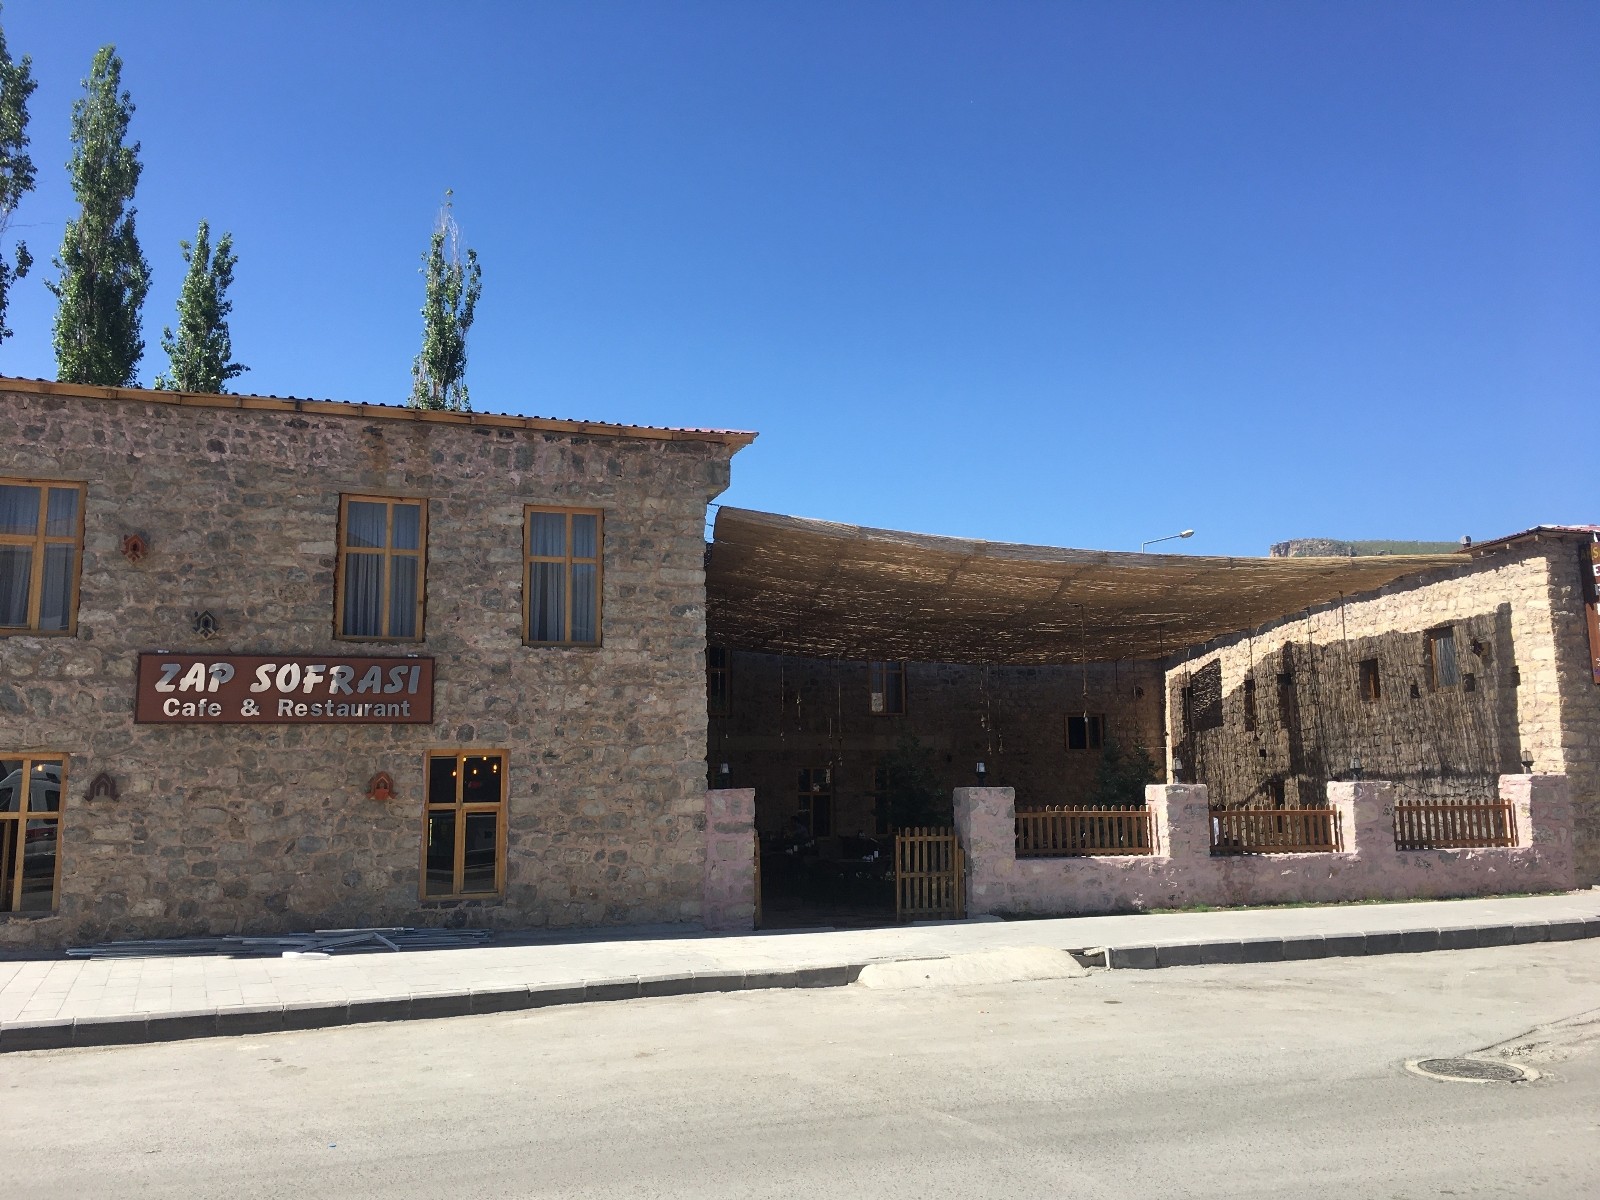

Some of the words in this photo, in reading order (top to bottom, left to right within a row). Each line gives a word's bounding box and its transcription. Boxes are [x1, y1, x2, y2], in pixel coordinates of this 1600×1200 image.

[154, 662, 235, 693] ZAP
[249, 662, 421, 696] SOFRASI
[162, 698, 222, 717] Cafe
[240, 698, 260, 717] &
[277, 698, 411, 717] Restaurant
